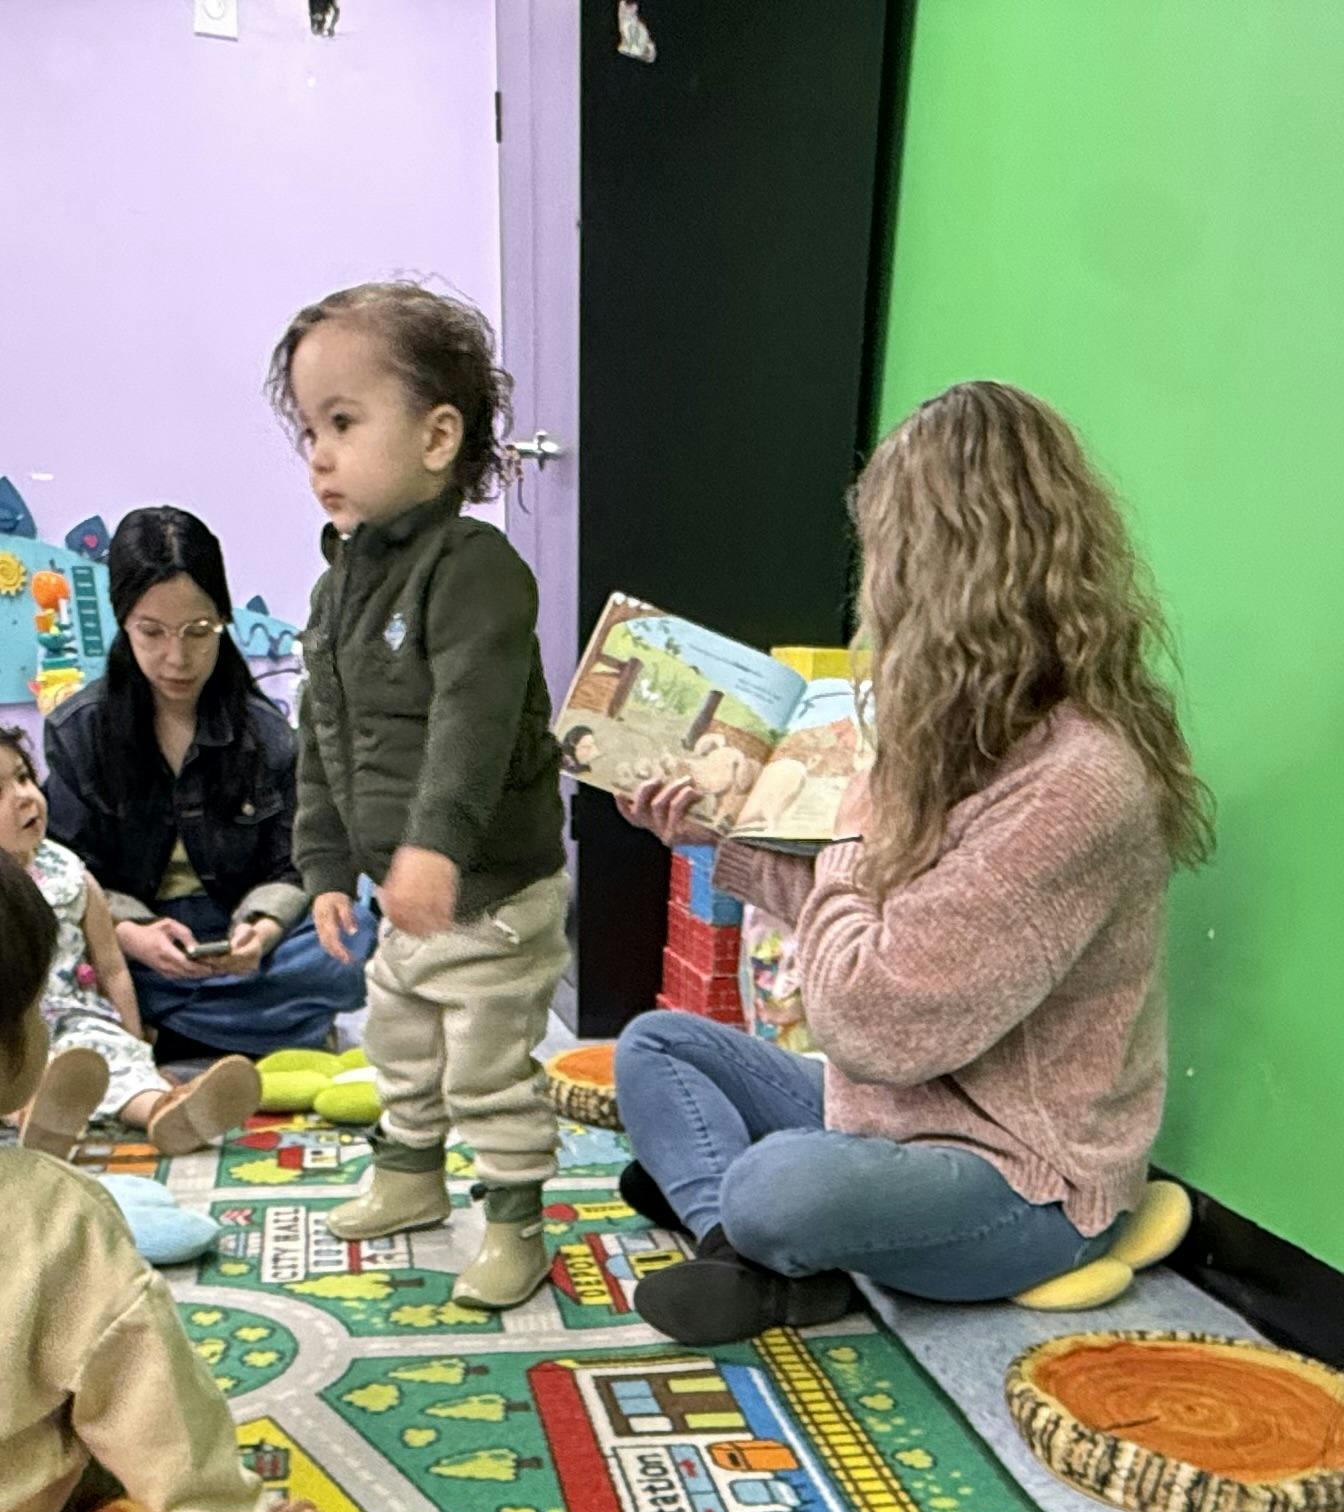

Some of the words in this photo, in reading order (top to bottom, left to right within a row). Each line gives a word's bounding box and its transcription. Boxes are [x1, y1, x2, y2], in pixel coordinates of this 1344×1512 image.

[273, 1208, 300, 1243] HALL
[272, 1246, 298, 1280] CITY
[566, 1252, 607, 1298] DEPOT
